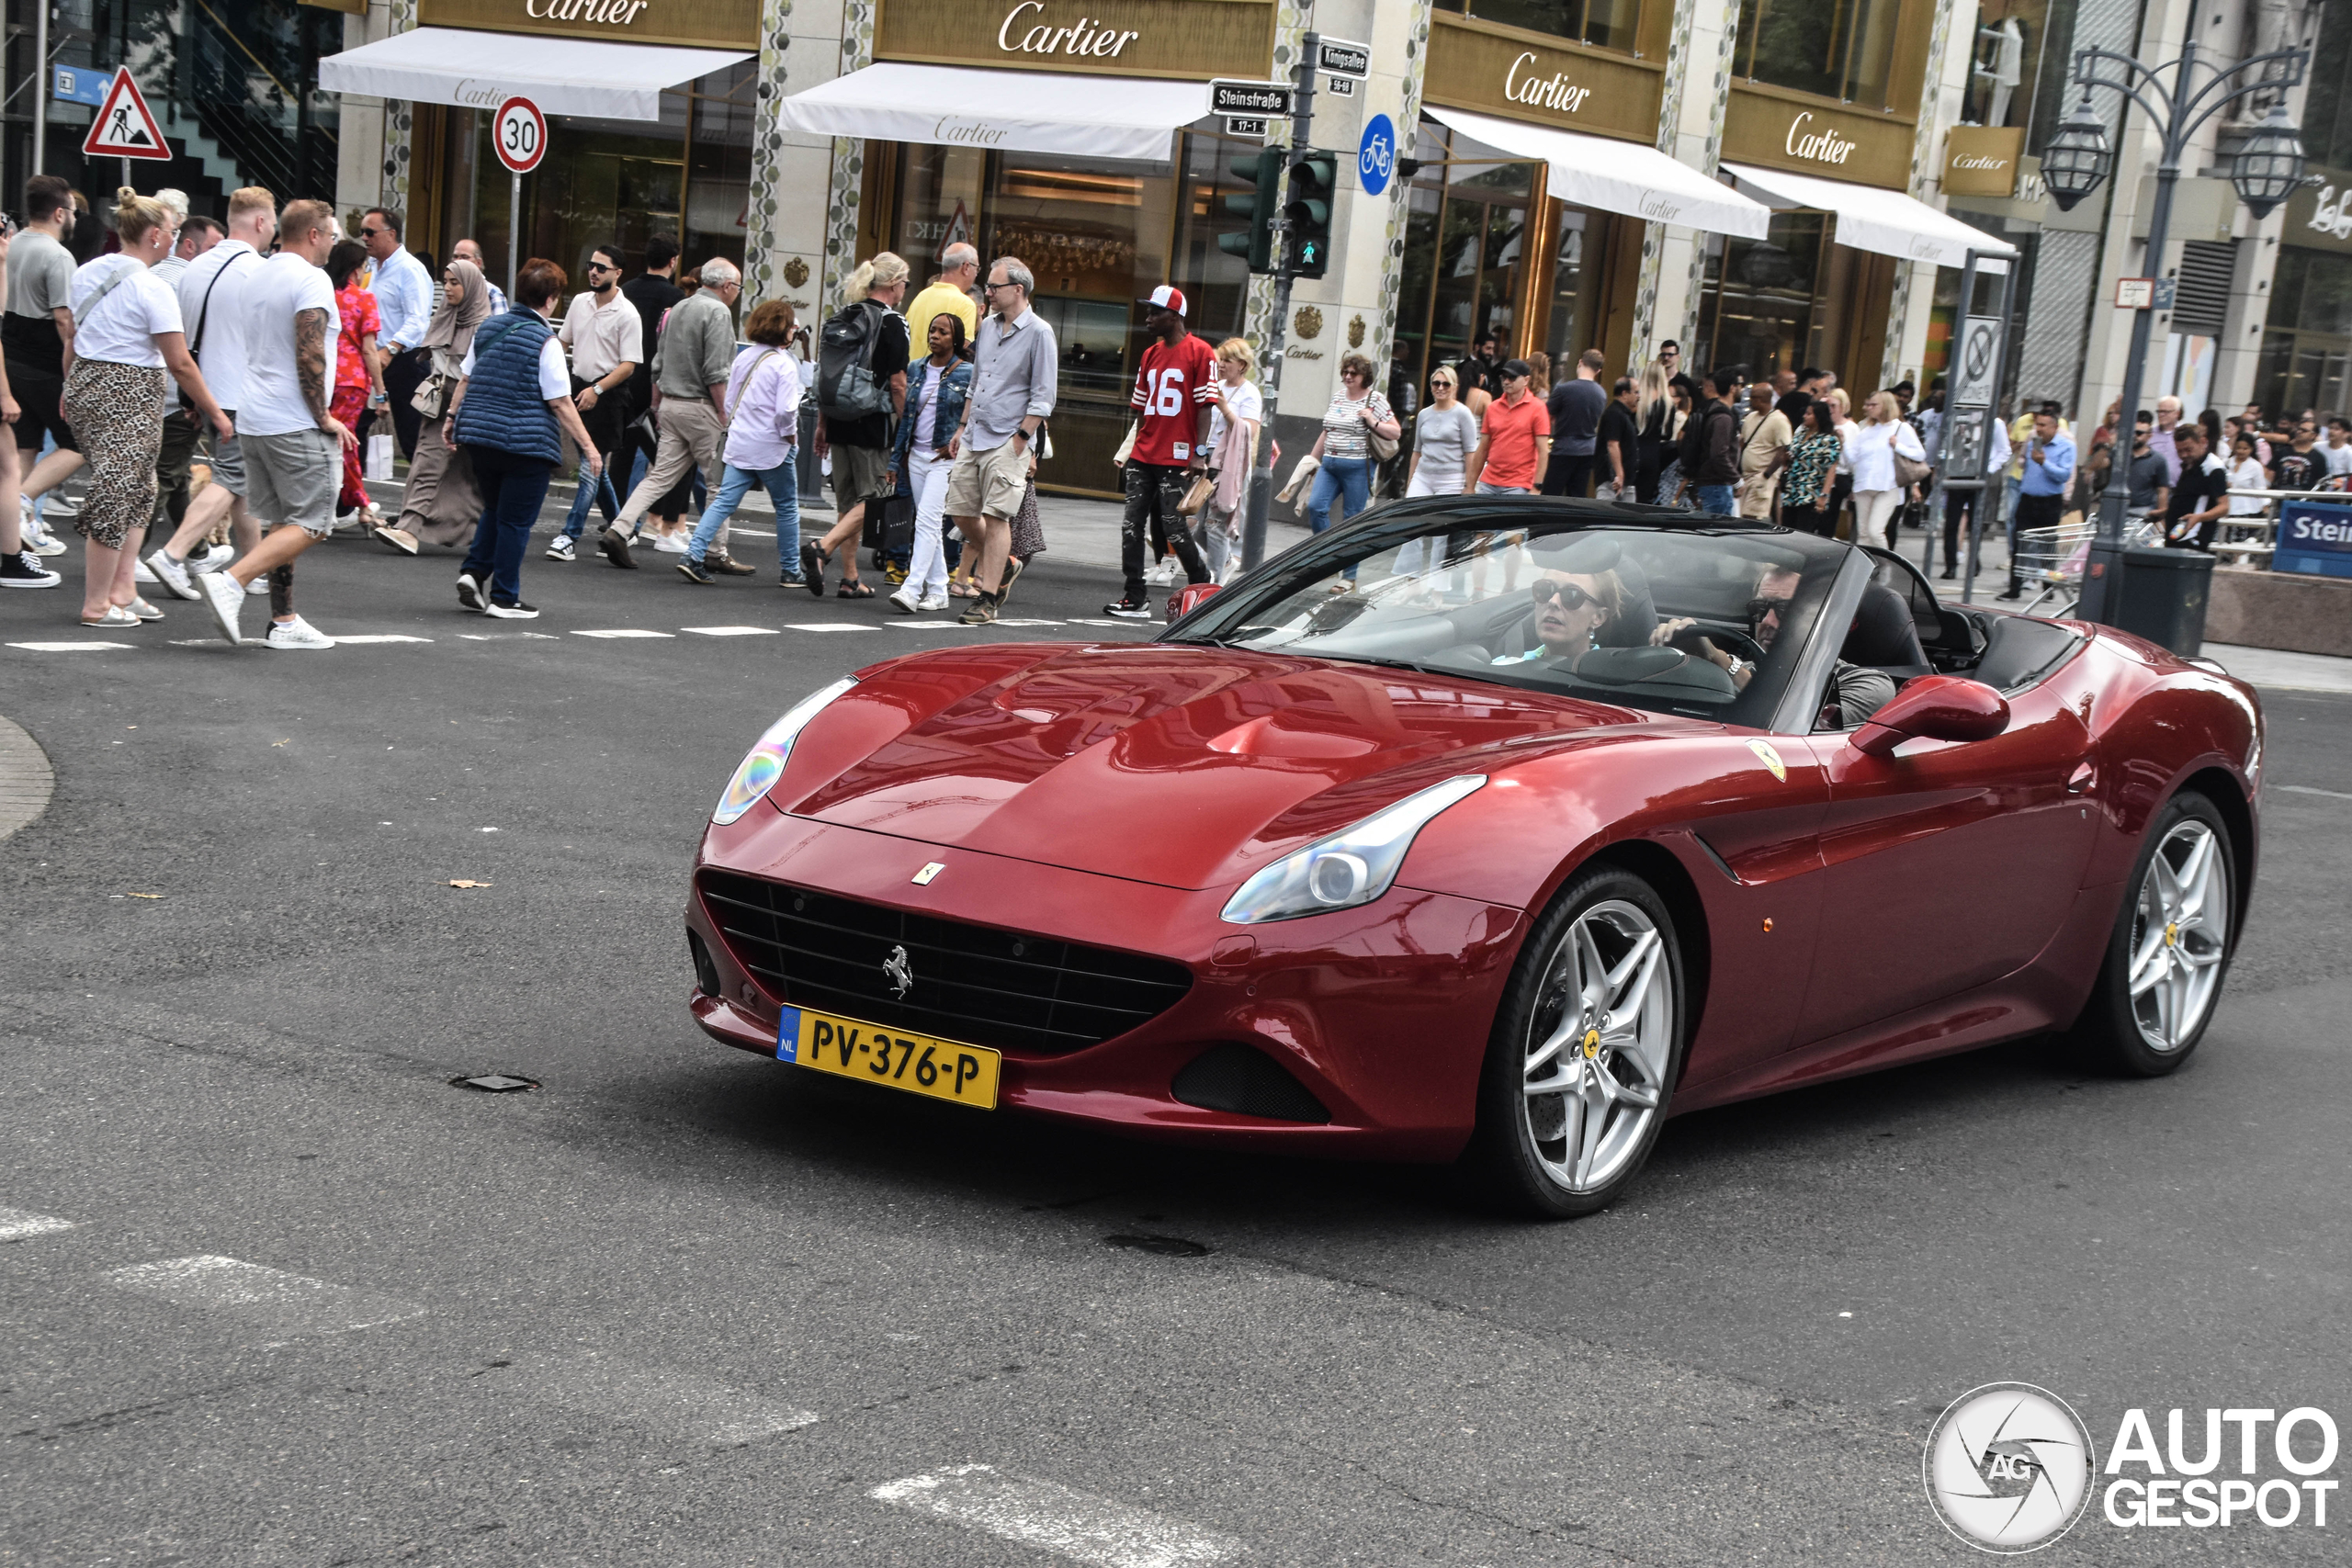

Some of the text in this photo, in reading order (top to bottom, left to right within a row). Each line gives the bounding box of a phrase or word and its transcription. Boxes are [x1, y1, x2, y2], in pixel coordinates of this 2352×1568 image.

[998, 1, 1138, 57] Cartier
[1324, 48, 1365, 70] Königsallee
[454, 77, 516, 106] Cartie
[1505, 51, 1590, 113] Cartier
[1218, 89, 1282, 109] Steinstraße
[505, 118, 535, 153] 30
[933, 114, 1007, 144] Cartier
[1238, 120, 1257, 131] 17-1
[1785, 111, 1855, 164] Cartier
[1951, 152, 2007, 171] Cartier
[1638, 188, 1680, 220] Cartier
[1908, 232, 1943, 259] Cartier
[1285, 344, 1324, 361] Cartier
[1144, 368, 1184, 417] 16
[2292, 516, 2352, 542] Stei
[781, 1020, 979, 1094] NL PV-376-P
